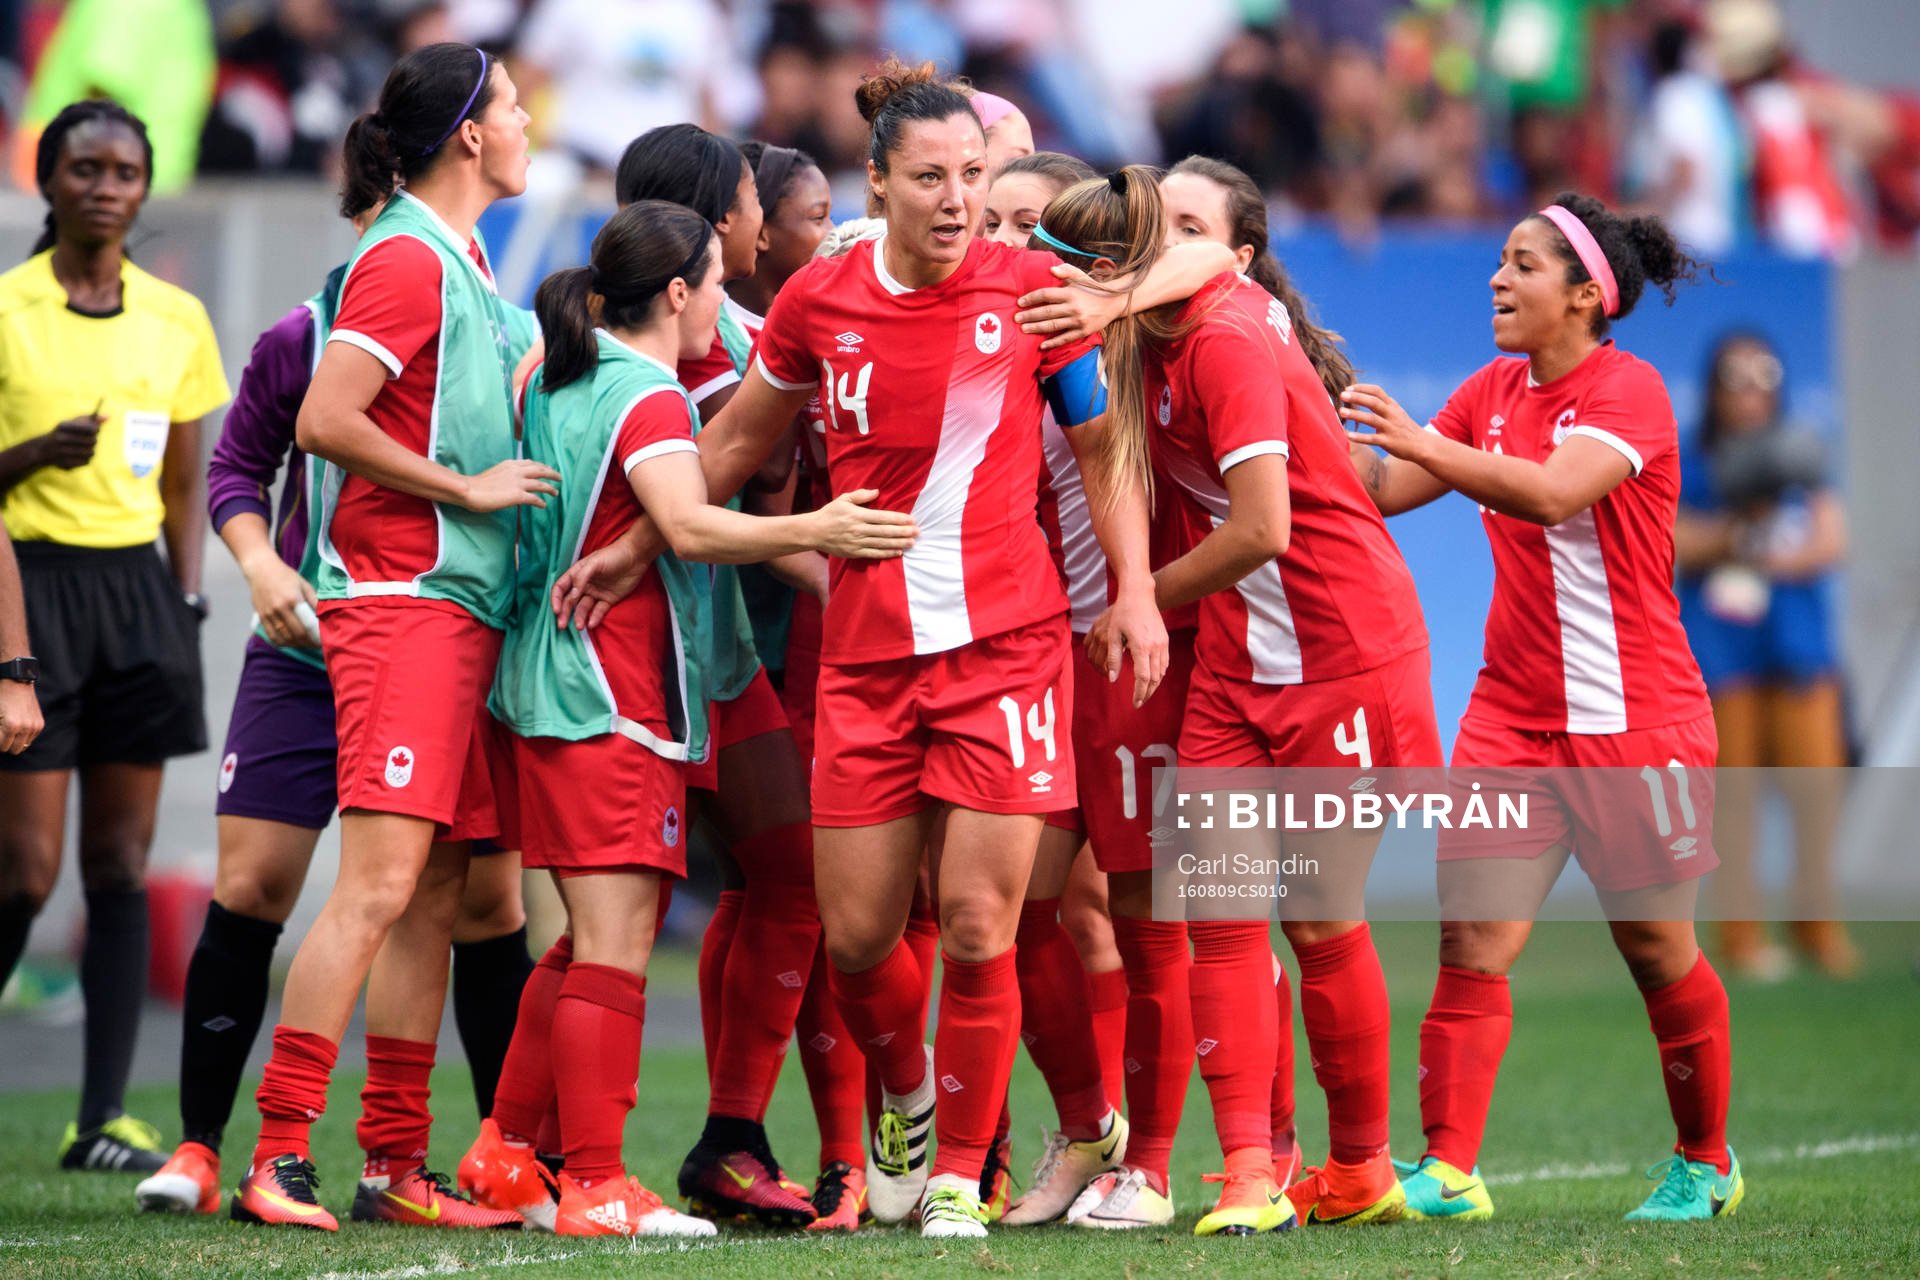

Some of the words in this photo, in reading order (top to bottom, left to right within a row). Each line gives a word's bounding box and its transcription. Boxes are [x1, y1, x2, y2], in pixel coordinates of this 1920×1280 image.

[836, 345, 861, 353] umbro
[822, 358, 874, 435] 14
[998, 687, 1056, 768] 14
[1333, 706, 1373, 771] 4
[1114, 743, 1178, 819] 17
[1640, 758, 1697, 837] 11
[585, 1209, 632, 1235] adidas
